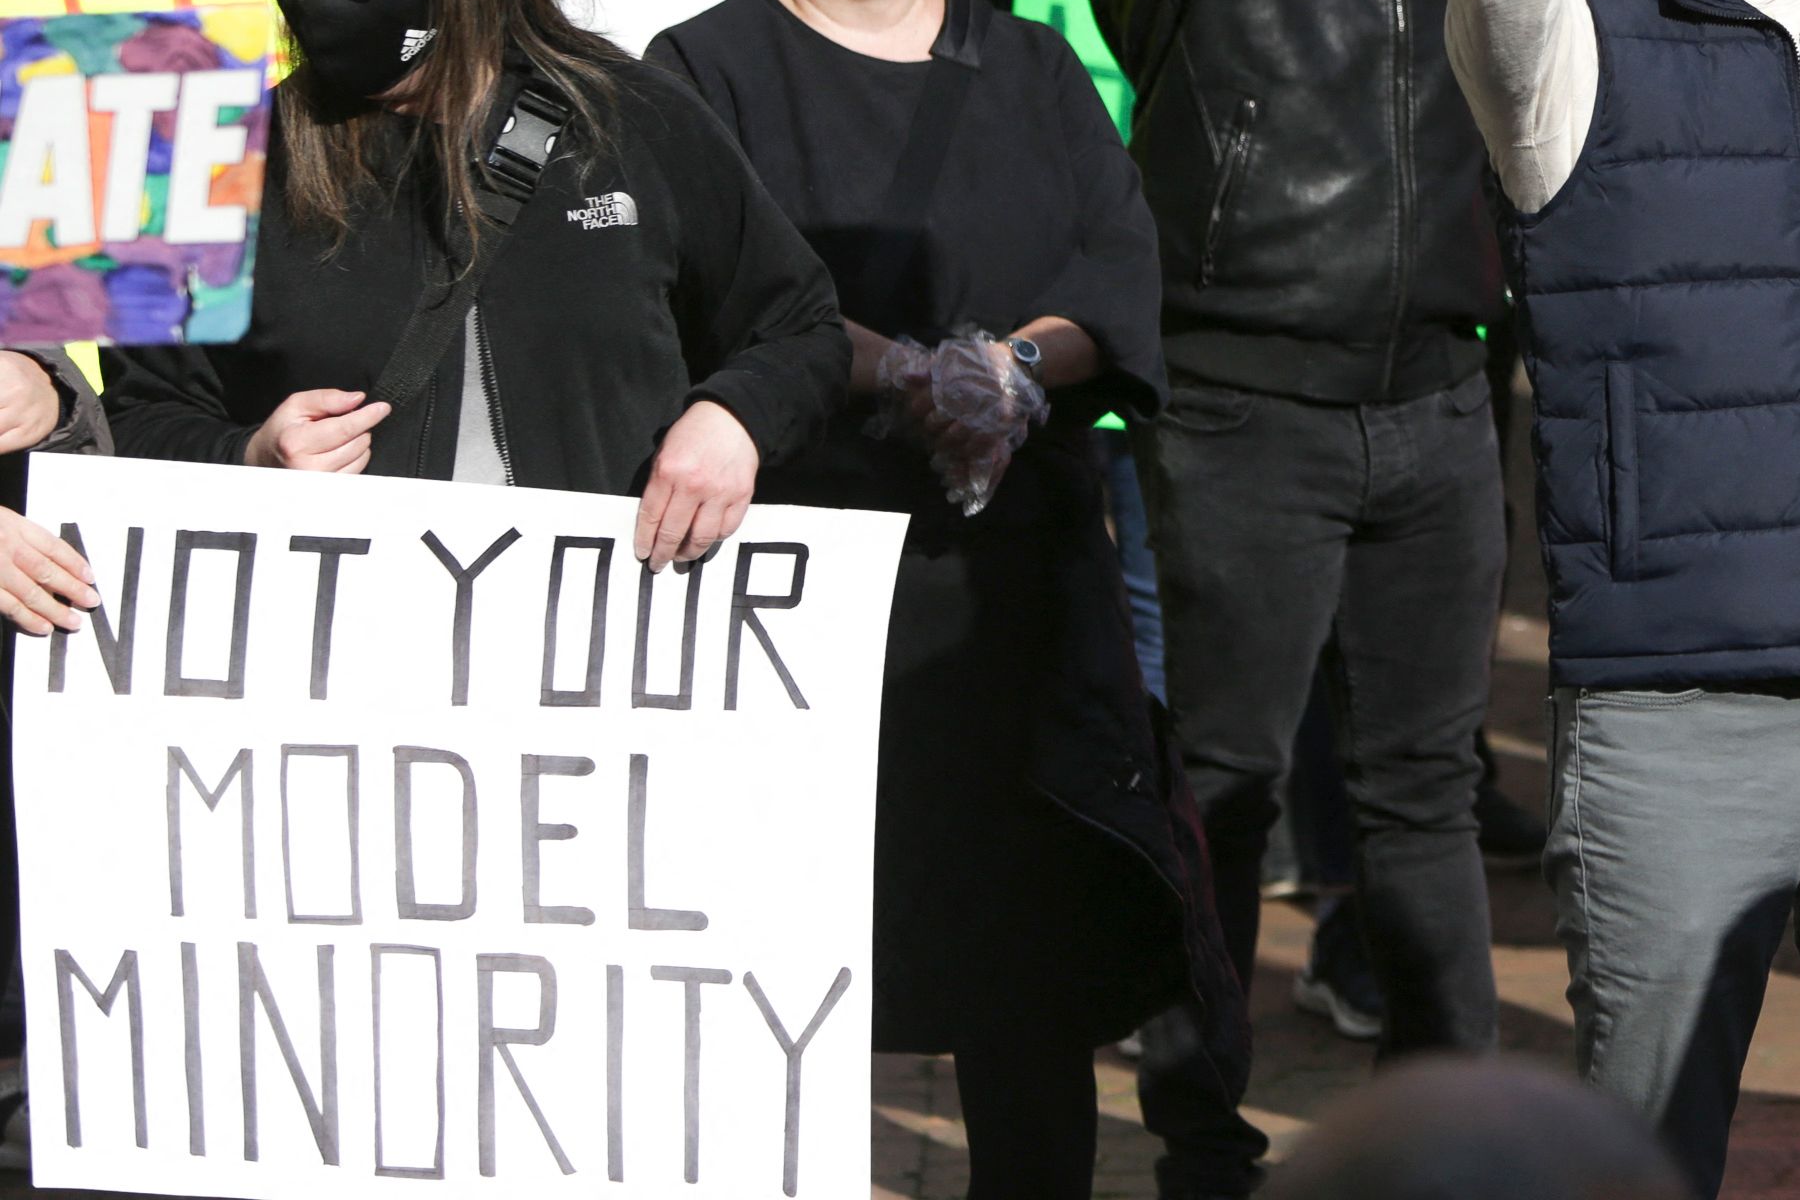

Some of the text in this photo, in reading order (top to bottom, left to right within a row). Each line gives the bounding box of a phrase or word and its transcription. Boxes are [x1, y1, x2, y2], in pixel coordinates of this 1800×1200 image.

[567, 203, 617, 222] NORTH
[582, 215, 619, 230] FACE
[585, 193, 614, 208] THE
[48, 522, 811, 711] NOT YOUR
[166, 744, 710, 932] MODEL
[54, 941, 853, 1199] MINORITY
